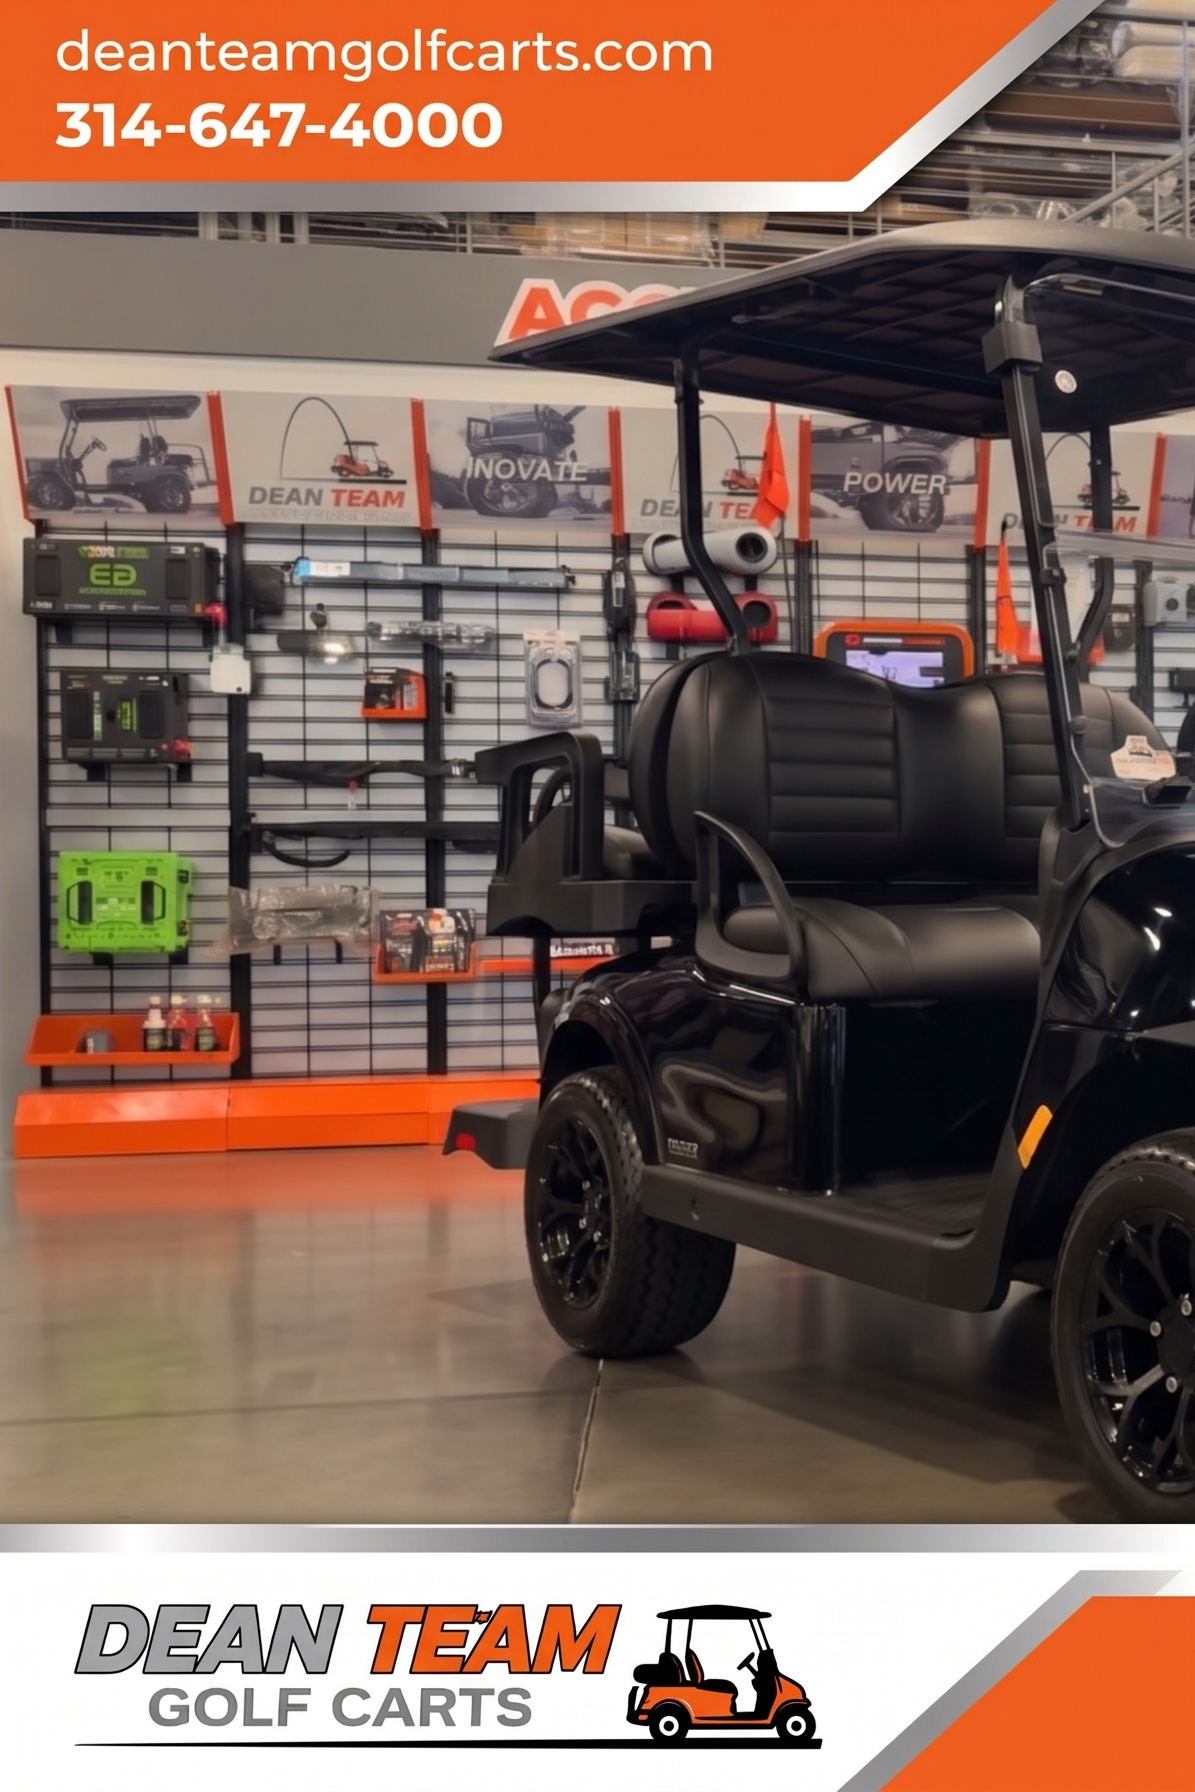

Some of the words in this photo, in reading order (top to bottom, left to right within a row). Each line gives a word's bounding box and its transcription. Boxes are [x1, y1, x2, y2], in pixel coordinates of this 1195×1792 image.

[466, 456, 588, 482] INOVATE
[842, 471, 946, 495] POWER
[248, 486, 323, 507] DEAN
[330, 488, 406, 509] TEAM
